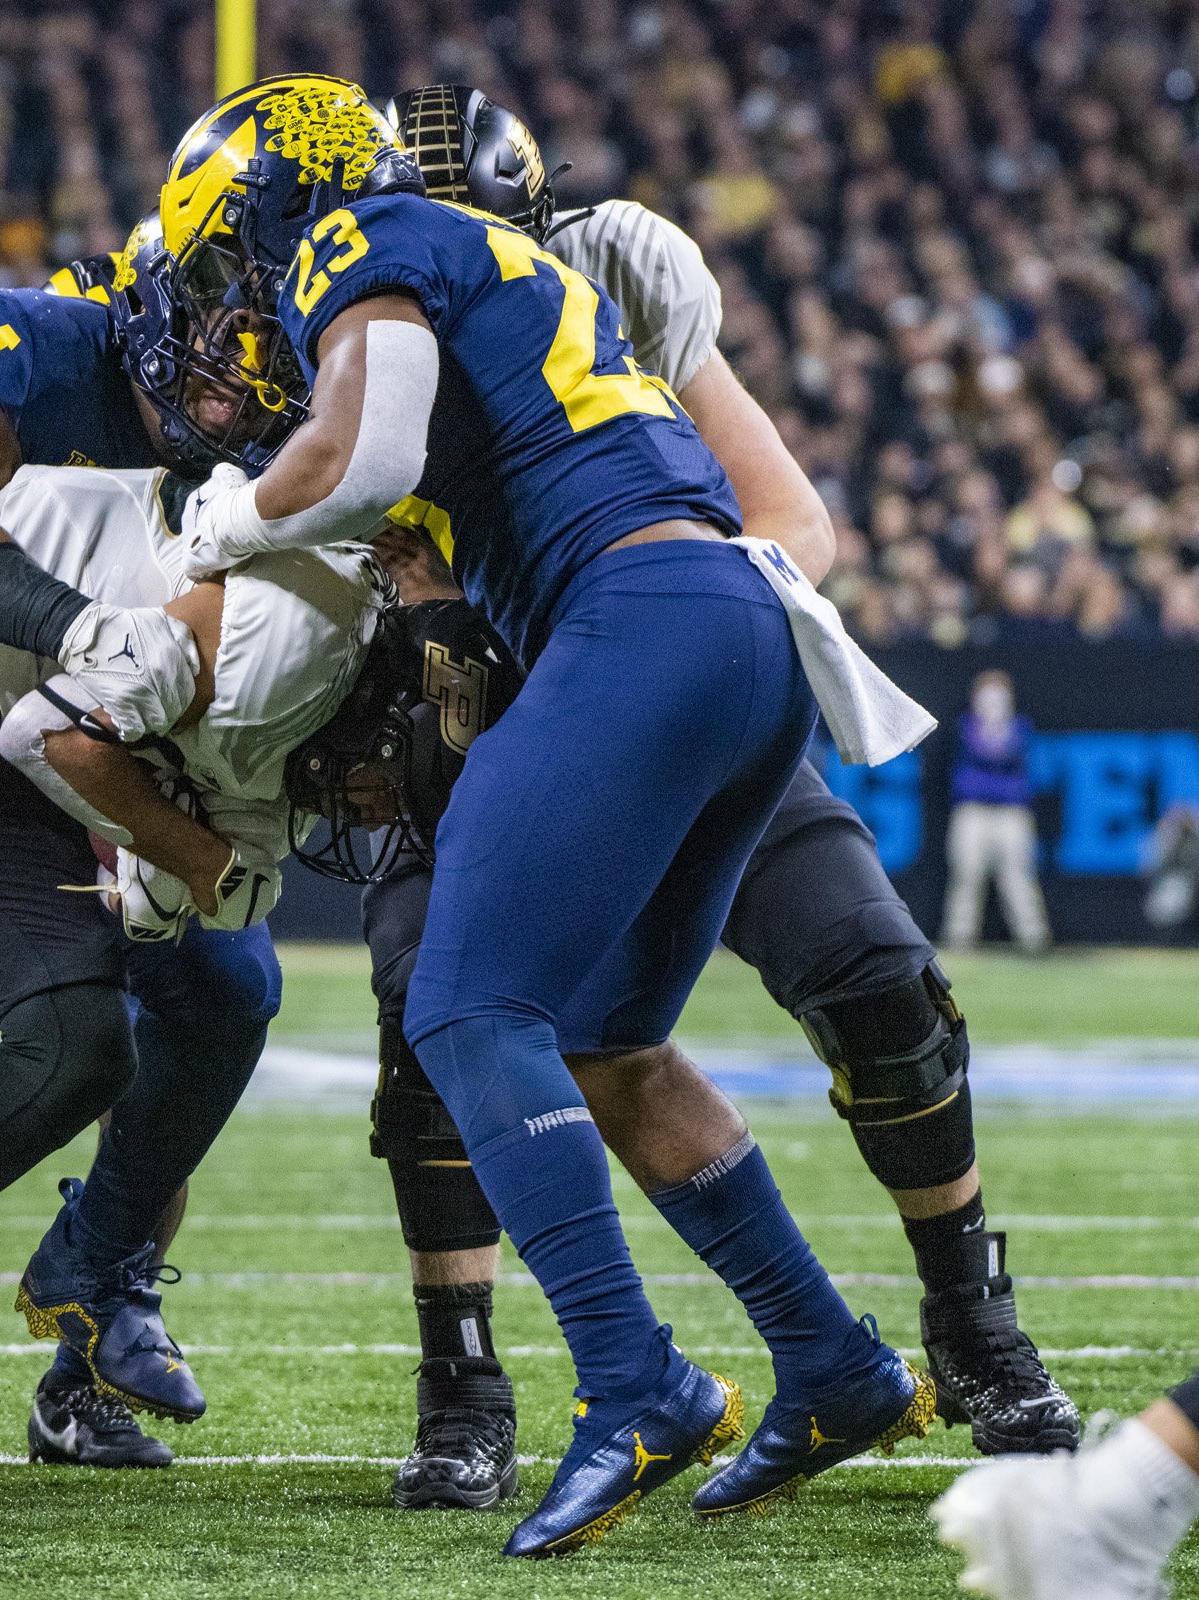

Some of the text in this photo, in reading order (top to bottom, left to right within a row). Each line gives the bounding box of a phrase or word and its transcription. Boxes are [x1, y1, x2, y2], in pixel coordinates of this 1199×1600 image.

[344, 174, 364, 188] TED
[286, 208, 370, 317] 23
[486, 225, 694, 433] 2
[422, 639, 489, 756] P
